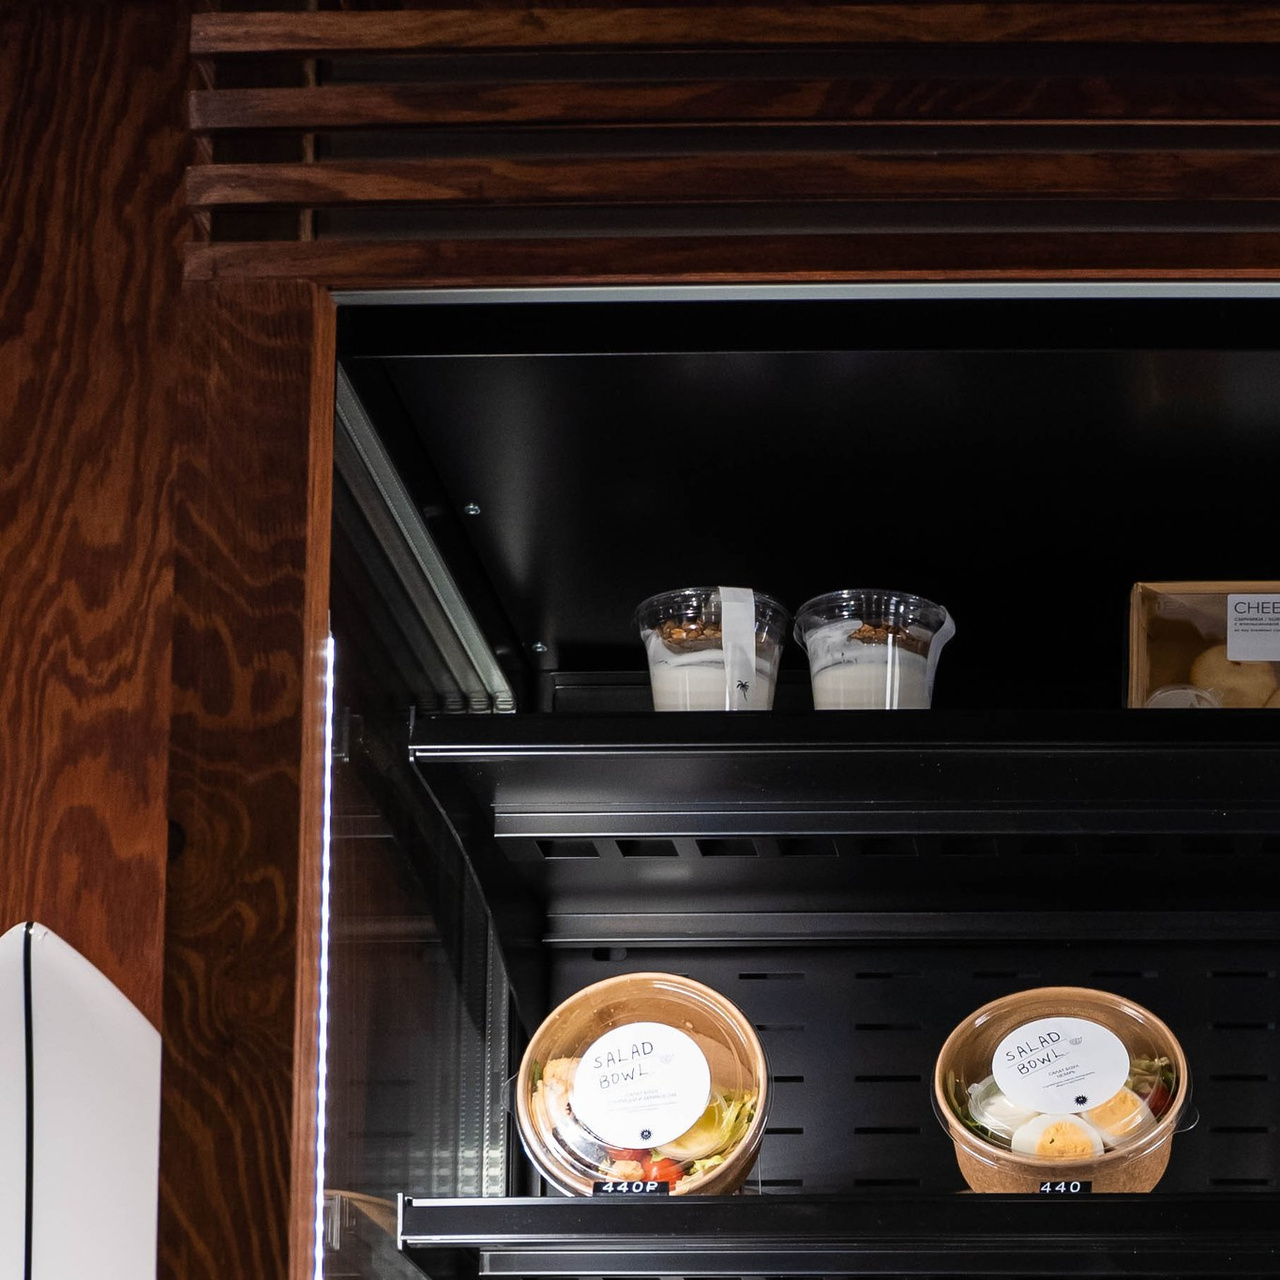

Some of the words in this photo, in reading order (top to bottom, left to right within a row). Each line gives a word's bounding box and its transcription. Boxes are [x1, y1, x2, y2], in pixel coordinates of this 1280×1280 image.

[593, 1041, 654, 1069] SALAD
[1005, 1031, 1061, 1062] SALAD
[1016, 1048, 1066, 1075] BOWL
[599, 1064, 649, 1089] BOWL
[1040, 1182, 1081, 1193] 440
